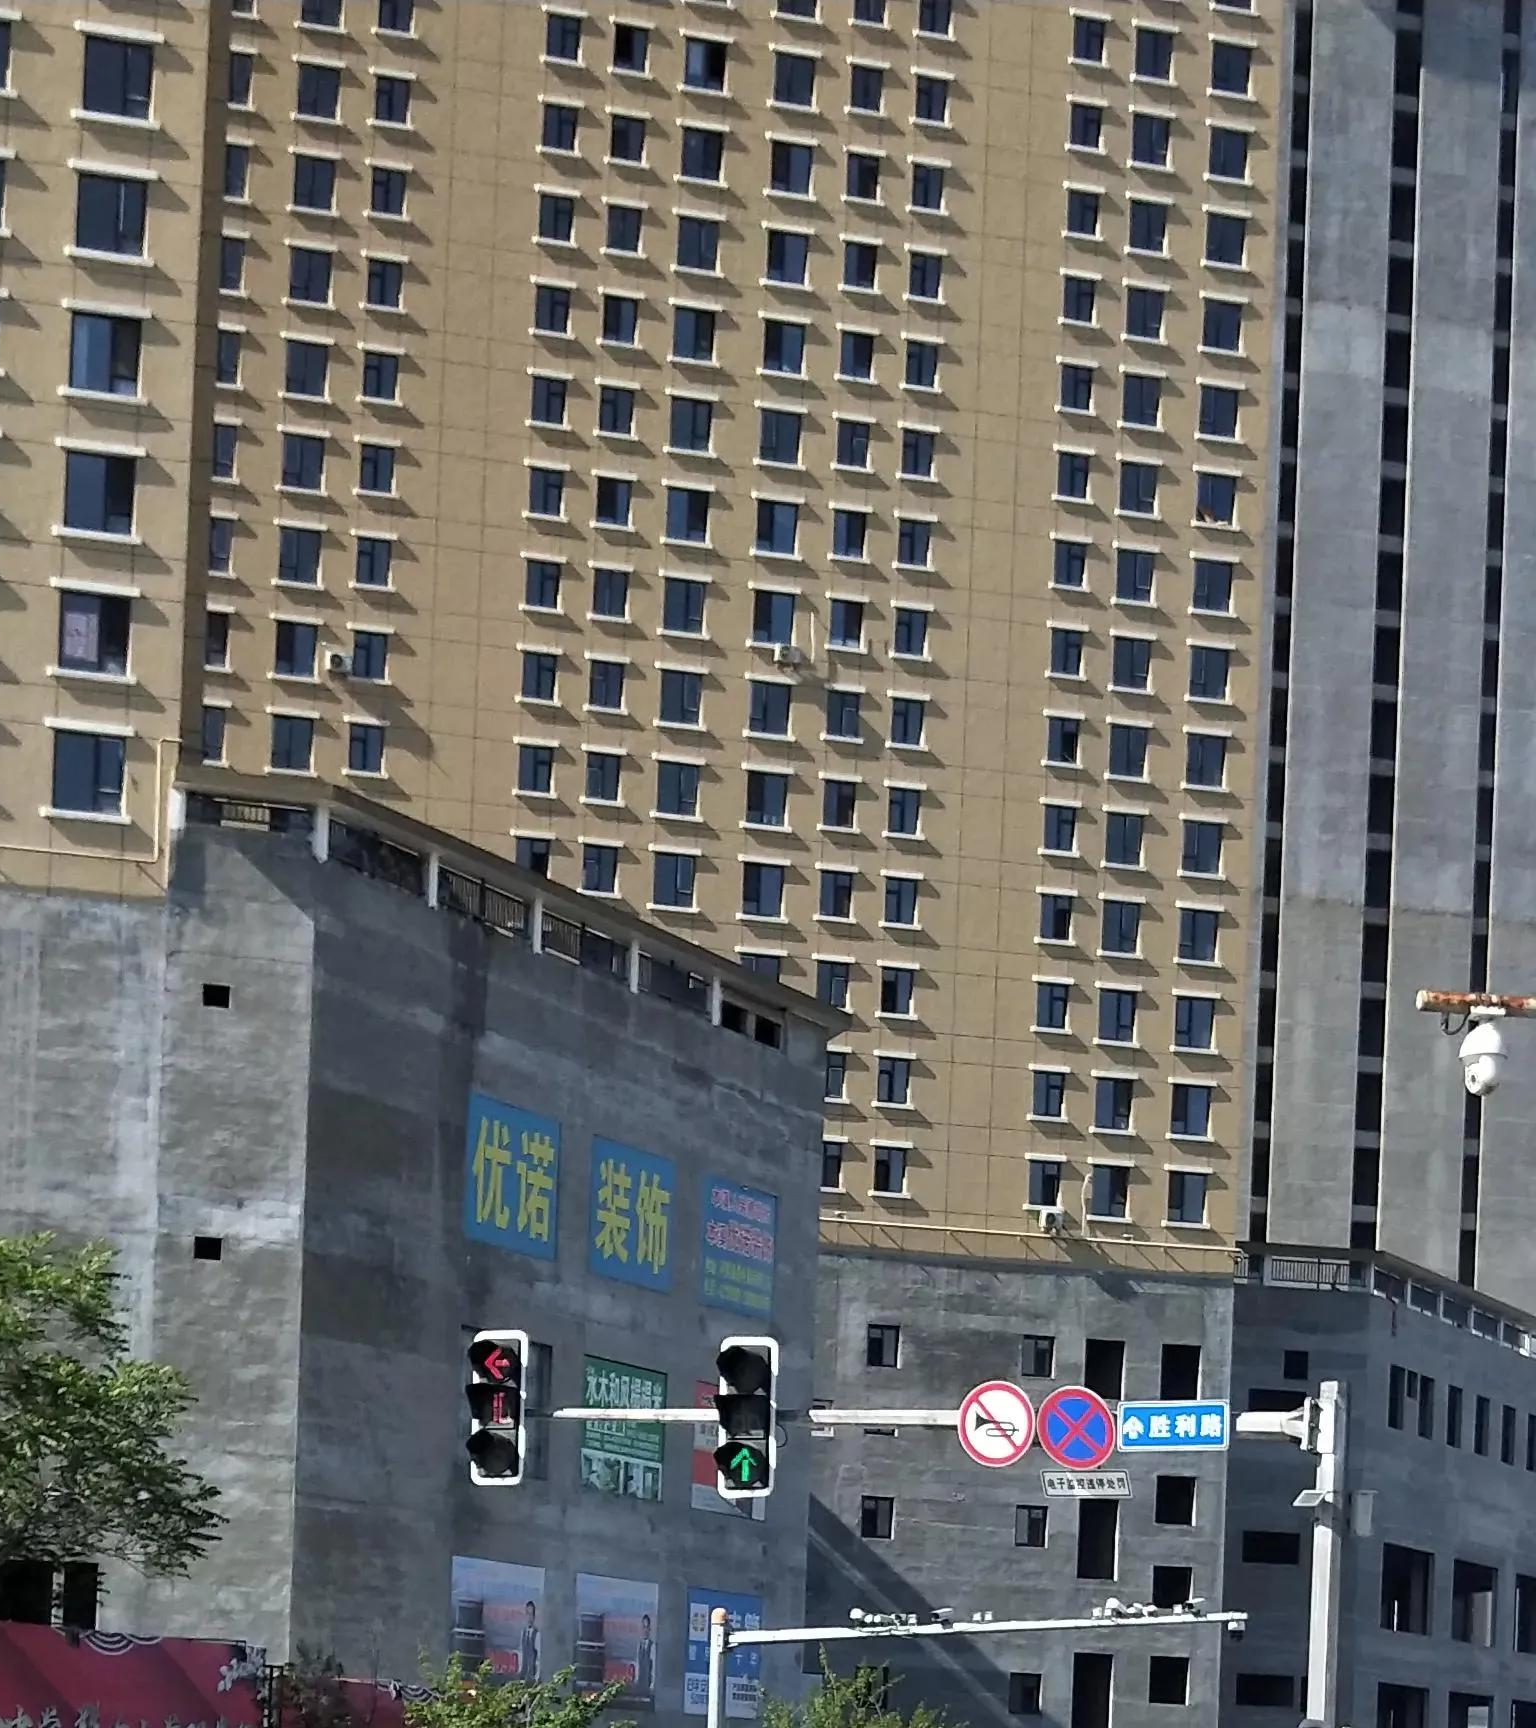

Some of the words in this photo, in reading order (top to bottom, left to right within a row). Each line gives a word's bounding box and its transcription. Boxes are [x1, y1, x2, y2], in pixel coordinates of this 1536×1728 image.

[473, 1116, 555, 1242] 优诺
[595, 1158, 670, 1275] 装饰
[1148, 1412, 1222, 1438] 胜利路
